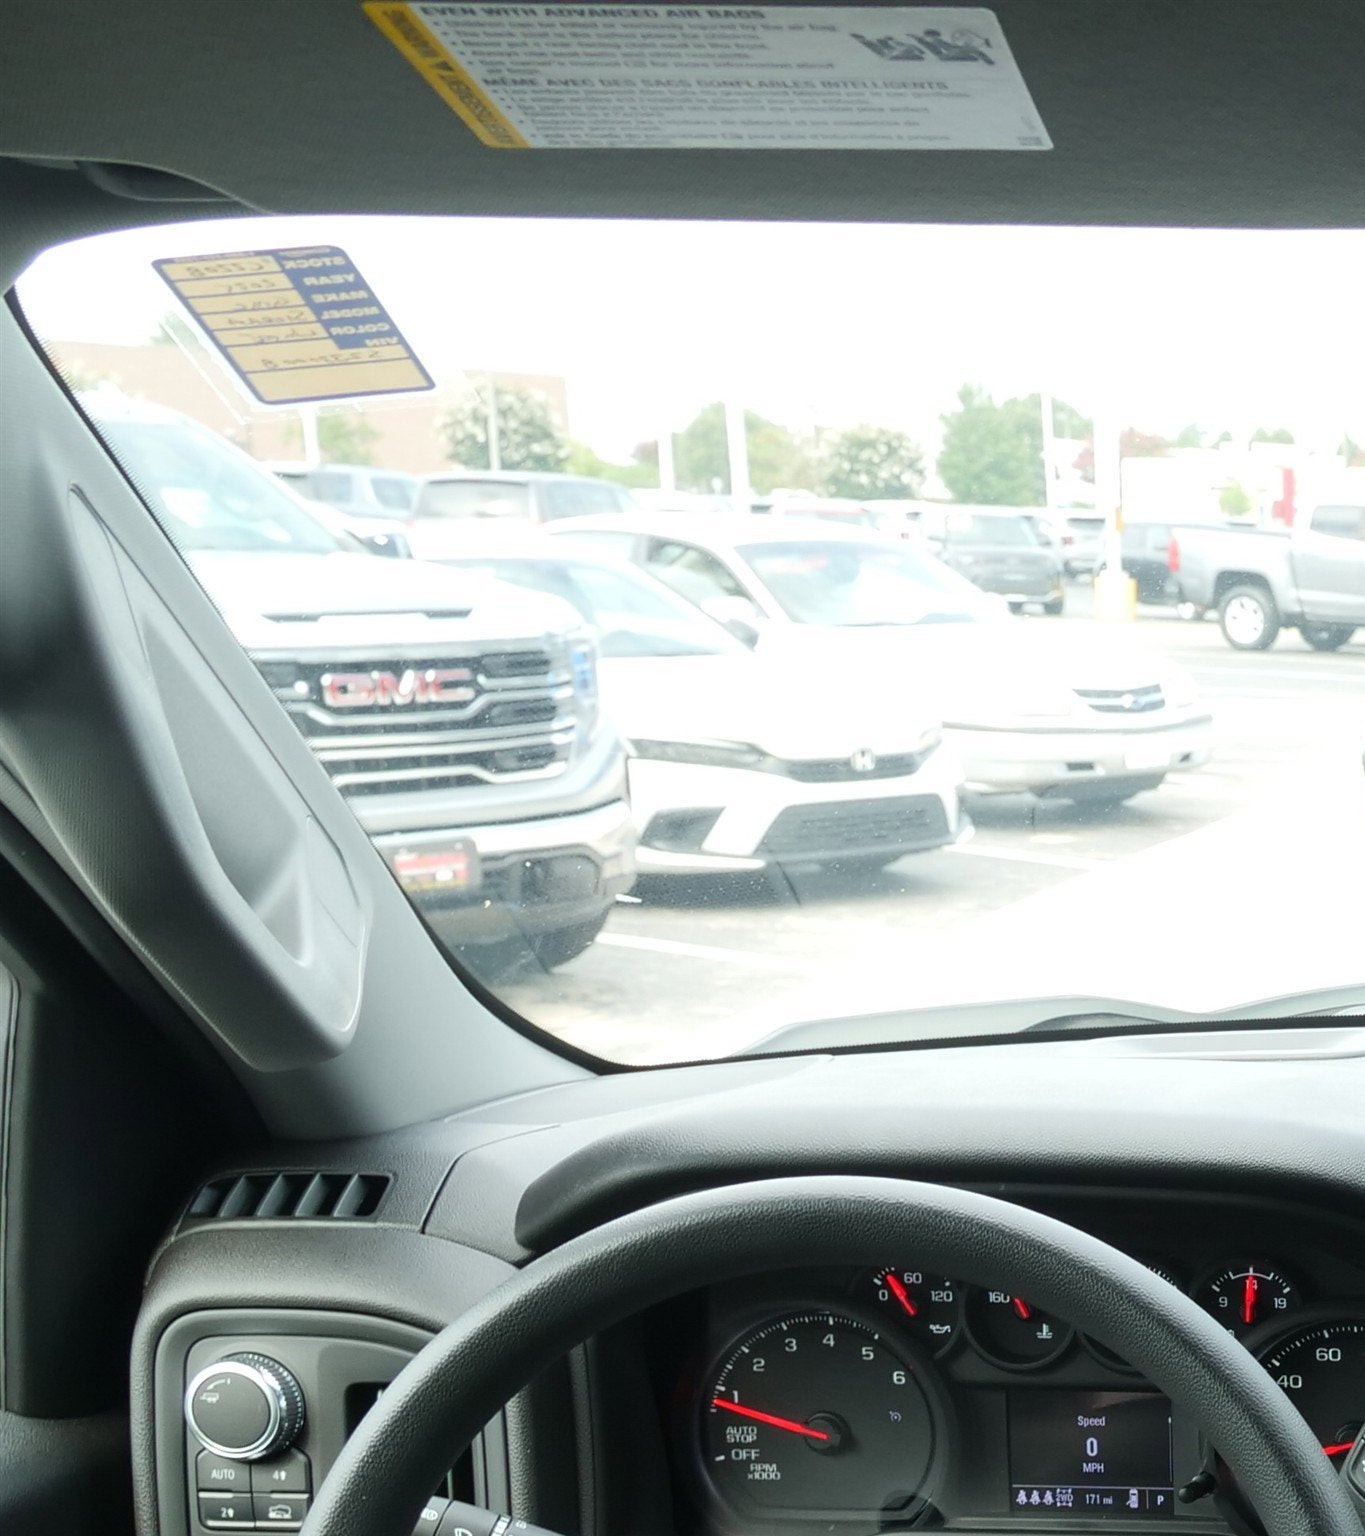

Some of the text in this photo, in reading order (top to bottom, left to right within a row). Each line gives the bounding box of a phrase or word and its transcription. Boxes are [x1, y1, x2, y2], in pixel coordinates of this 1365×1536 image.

[321, 668, 476, 707] GMC
[904, 1272, 922, 1284] 60
[879, 1289, 889, 1301] 0
[931, 1290, 953, 1302] 120
[1219, 1297, 1228, 1308] 9
[1274, 1298, 1287, 1309] 19
[785, 1338, 797, 1352] 3
[823, 1333, 835, 1347] 4
[862, 1347, 874, 1360] 5
[1316, 1348, 1341, 1361] 60
[753, 1358, 765, 1372] 2
[893, 1371, 906, 1385] 6
[1278, 1375, 1302, 1389] 40
[733, 1390, 738, 1403] 1
[1077, 1415, 1106, 1427] Speed
[726, 1426, 757, 1435] AUTO
[726, 1434, 757, 1443] STOP
[1086, 1437, 1098, 1457] 0
[731, 1449, 760, 1460] OFF
[750, 1463, 777, 1472] RPM
[1083, 1462, 1105, 1473] MPH
[211, 1469, 235, 1480] AUTO
[747, 1471, 781, 1480] x1000
[1085, 1494, 1113, 1504] 171 mi
[1157, 1495, 1164, 1506] P
